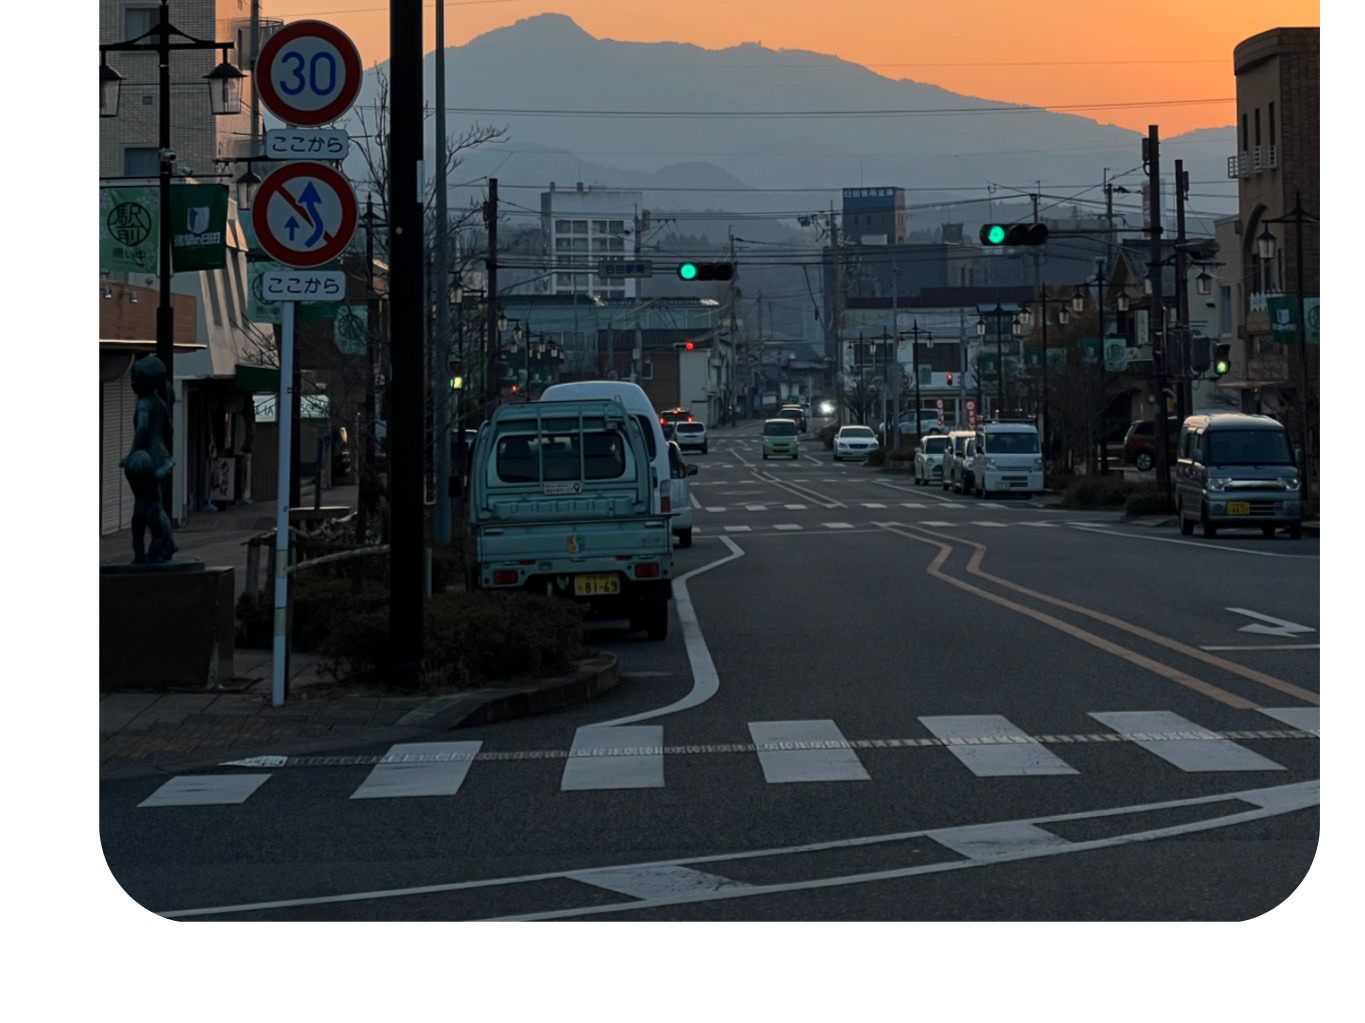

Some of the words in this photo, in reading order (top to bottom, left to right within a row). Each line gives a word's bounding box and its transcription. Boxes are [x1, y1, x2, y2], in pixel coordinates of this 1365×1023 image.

[279, 51, 337, 96] 30
[272, 136, 343, 153] ここから
[110, 203, 151, 246] 駅前
[268, 277, 340, 294] ここから
